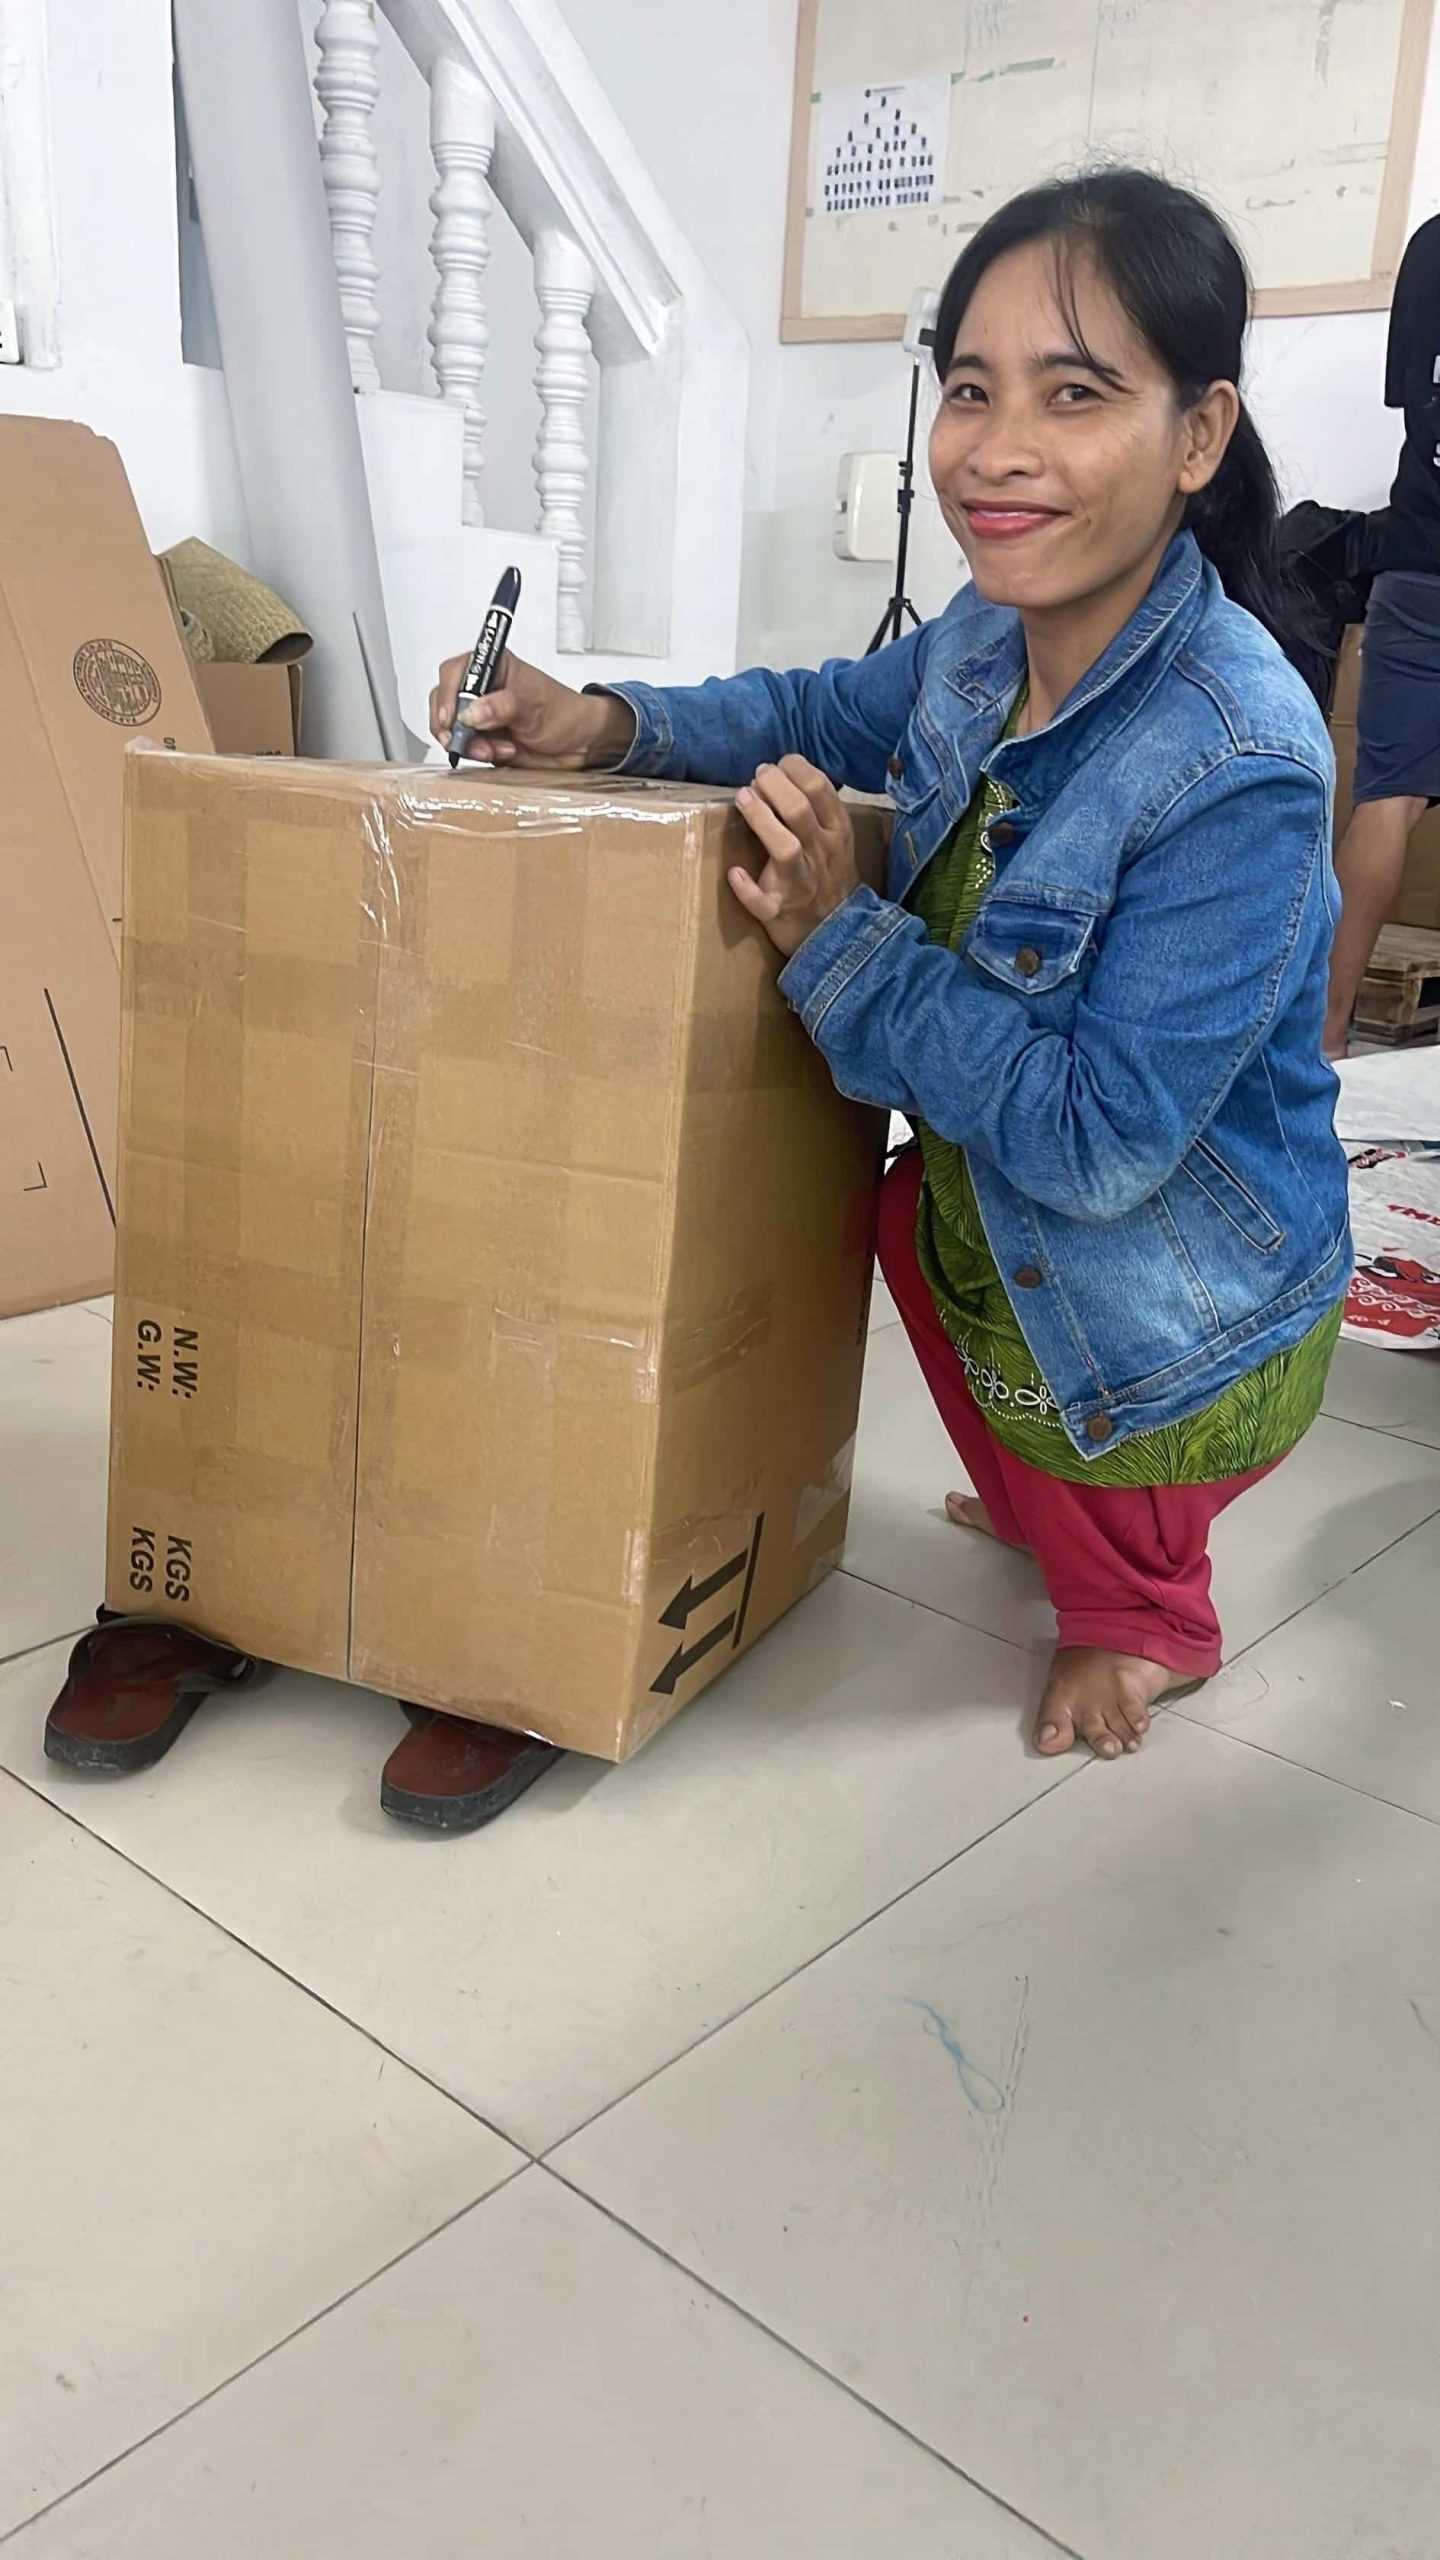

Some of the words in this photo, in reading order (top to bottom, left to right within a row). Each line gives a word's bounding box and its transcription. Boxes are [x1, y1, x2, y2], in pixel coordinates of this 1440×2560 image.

[136, 1319, 162, 1392] G.W:
[172, 1326, 199, 1399] N.W:
[129, 1526, 156, 1593] KGS
[165, 1535, 193, 1602] KGS
